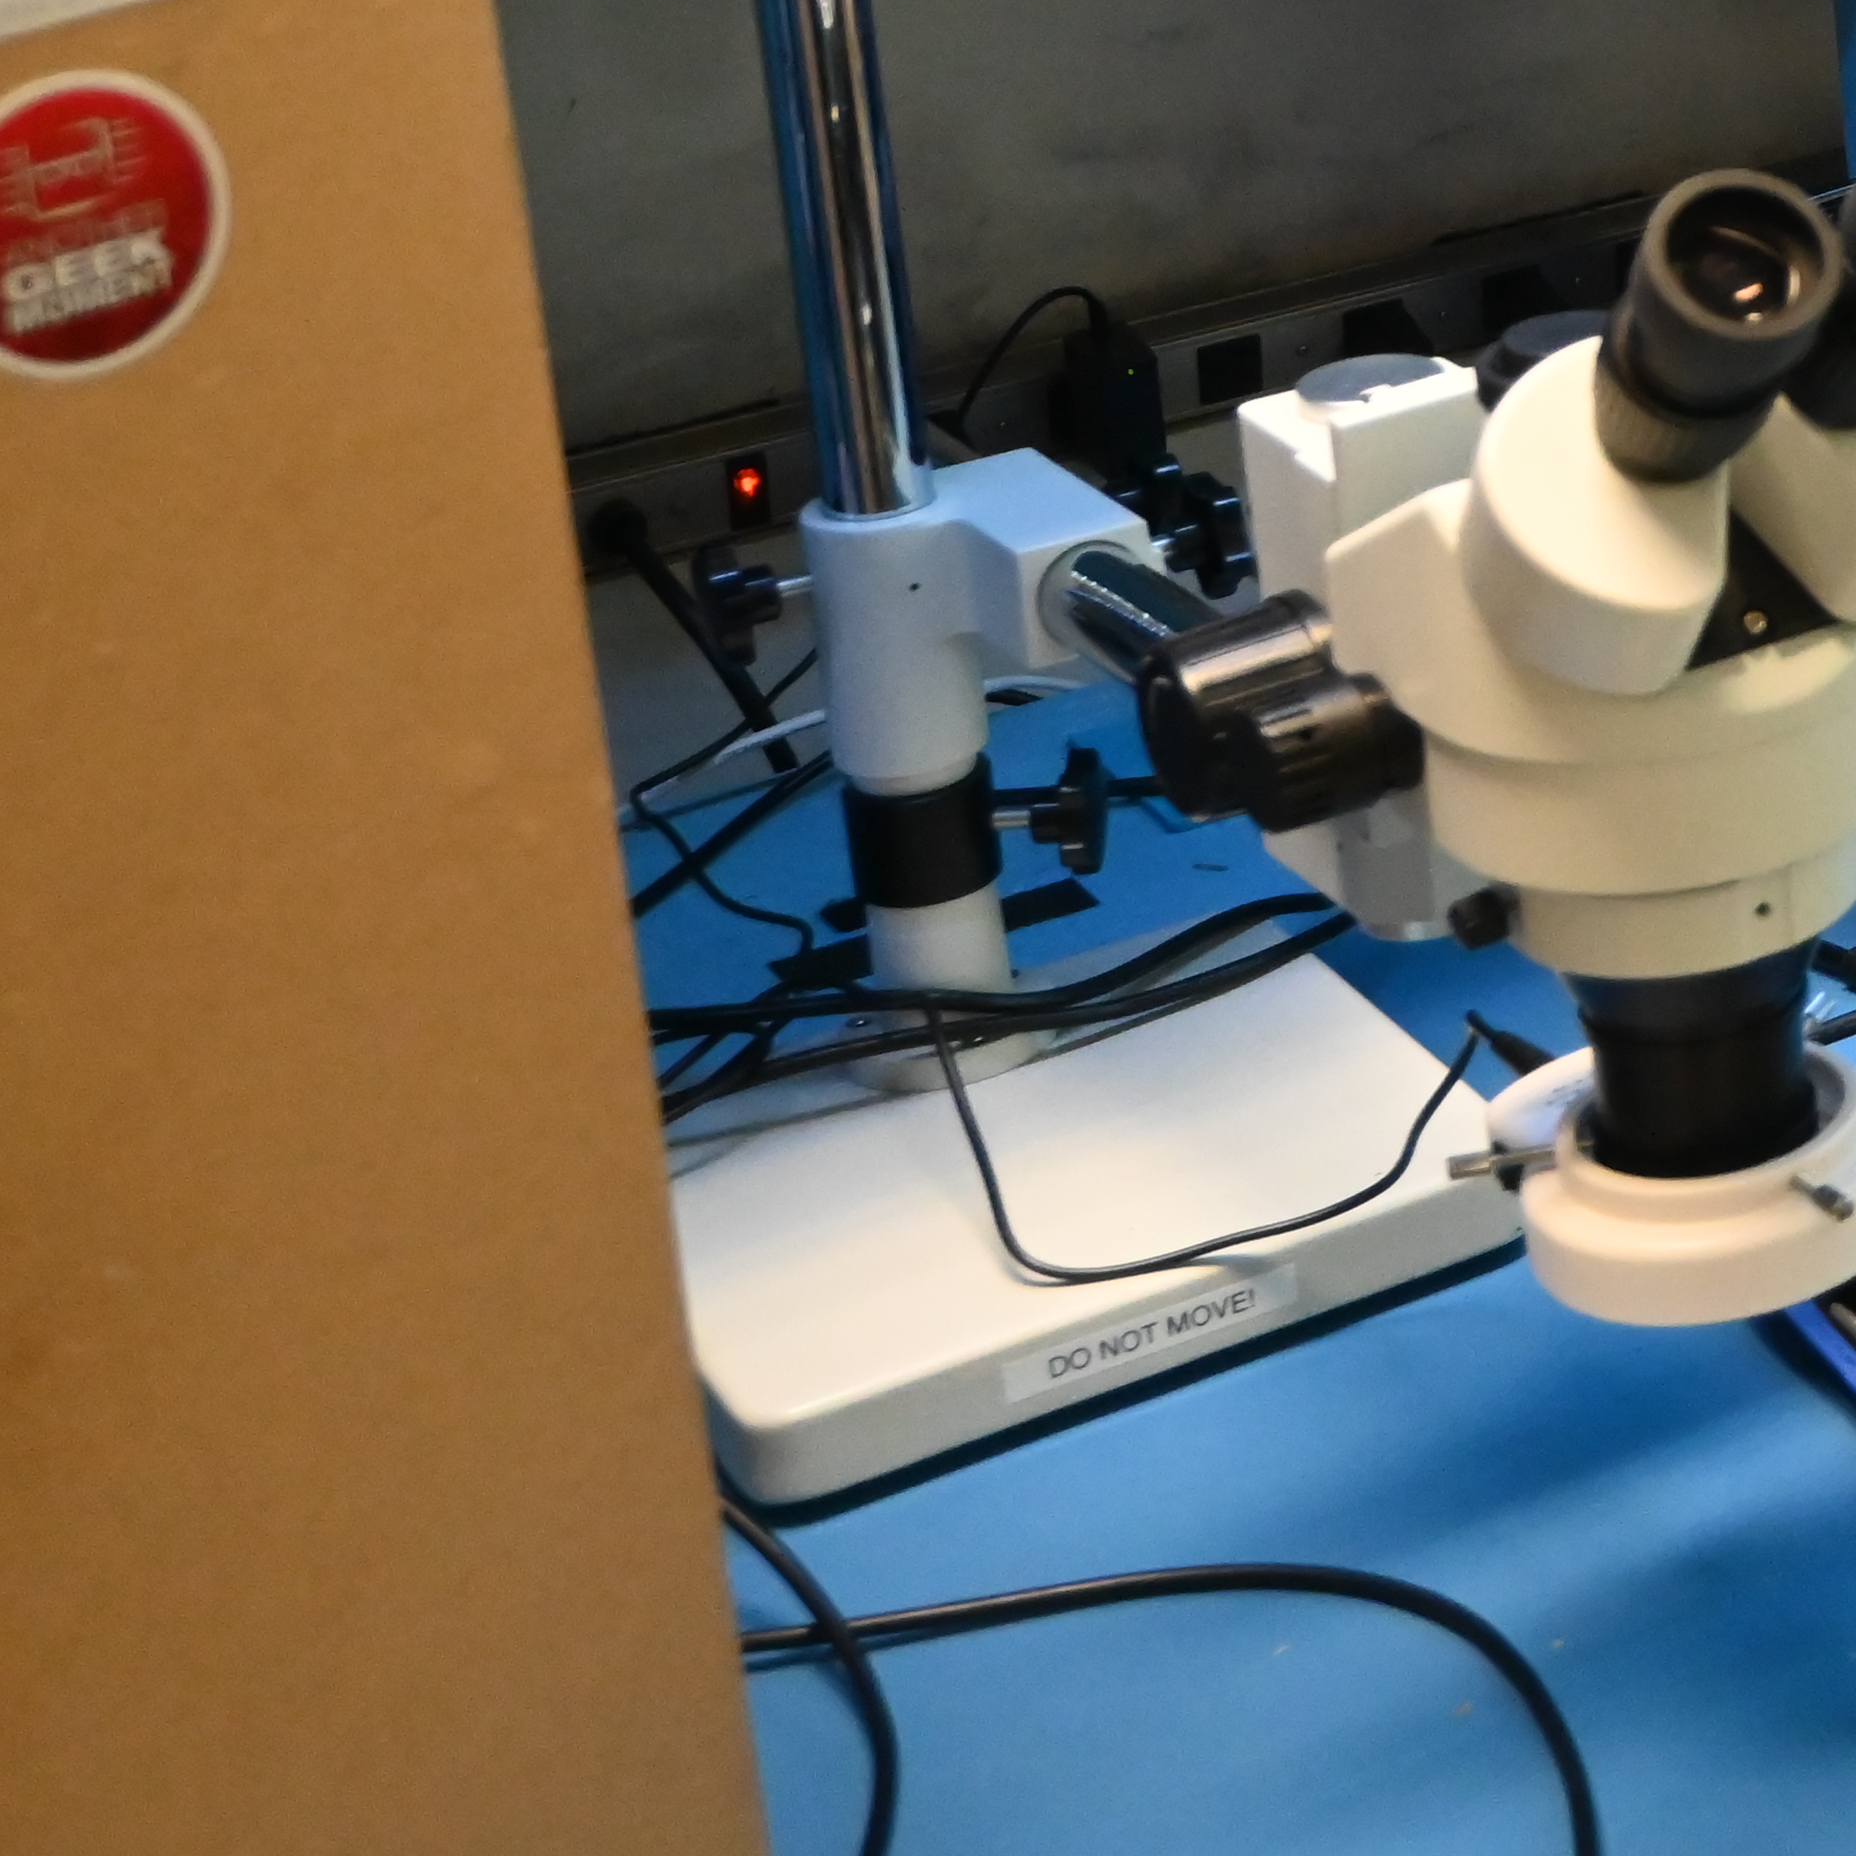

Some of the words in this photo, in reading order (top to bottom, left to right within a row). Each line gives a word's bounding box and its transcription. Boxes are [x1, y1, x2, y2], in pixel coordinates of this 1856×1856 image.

[1048, 1347, 1092, 1379] DO
[1100, 1321, 1159, 1360] NOT
[1167, 1288, 1257, 1336] MOVE!
